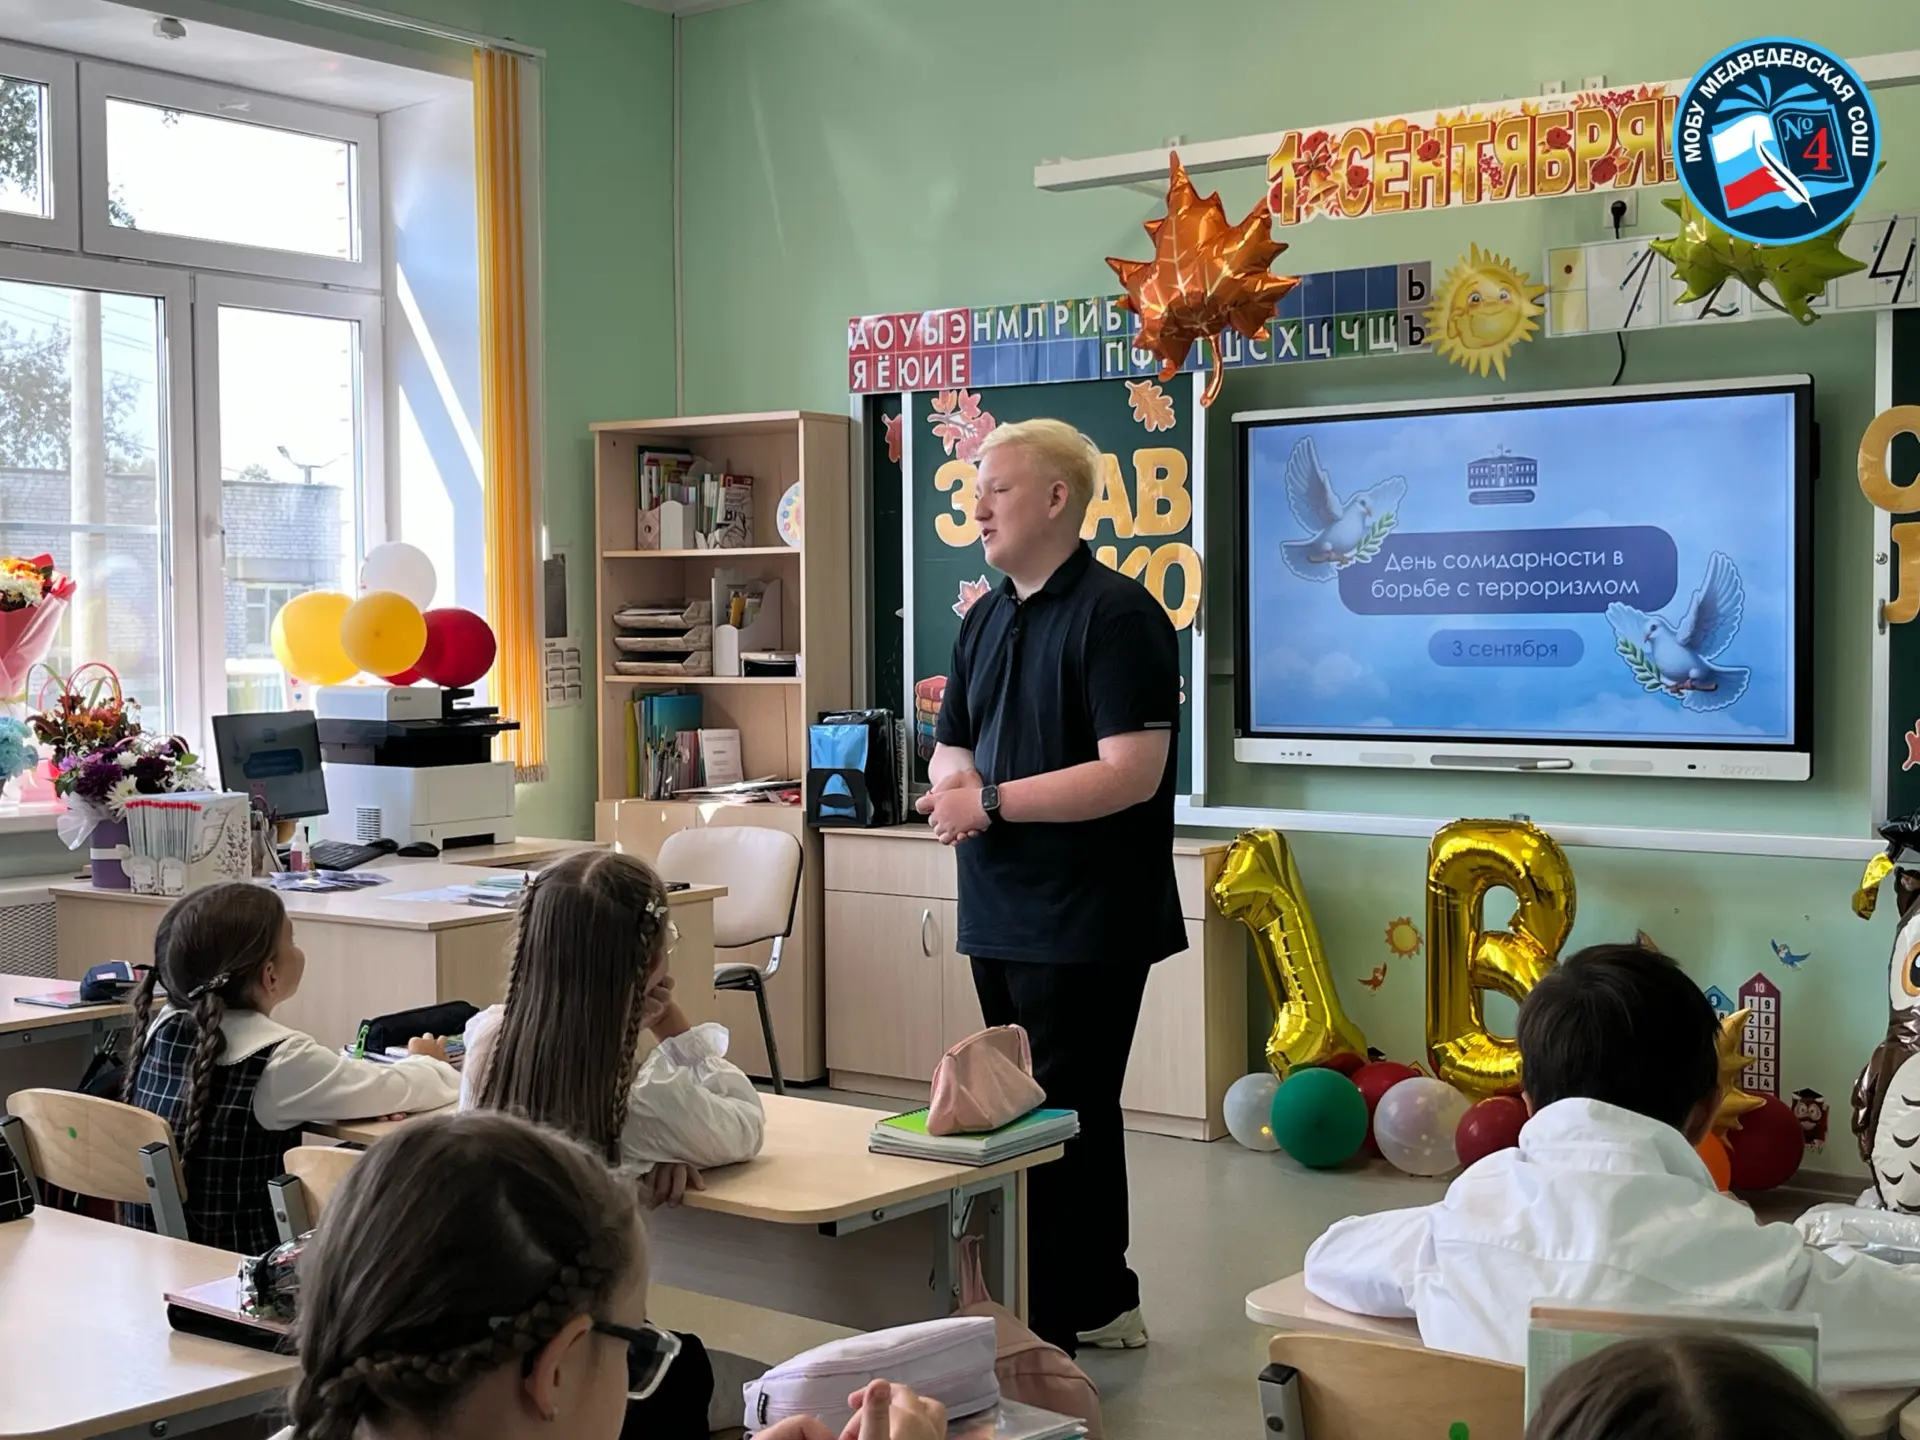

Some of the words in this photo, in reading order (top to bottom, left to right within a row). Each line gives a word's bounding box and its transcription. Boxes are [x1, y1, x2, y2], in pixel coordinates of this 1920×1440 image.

[1384, 552, 1437, 572] День
[1443, 550, 1605, 571] солидарности
[1613, 551, 1624, 566] в
[1371, 578, 1450, 601] борьбе
[1457, 581, 1471, 596] с
[1477, 578, 1640, 600] терроризмом
[1453, 640, 1463, 657] 3
[1468, 639, 1558, 661] сентября
[1754, 983, 1765, 993] 10
